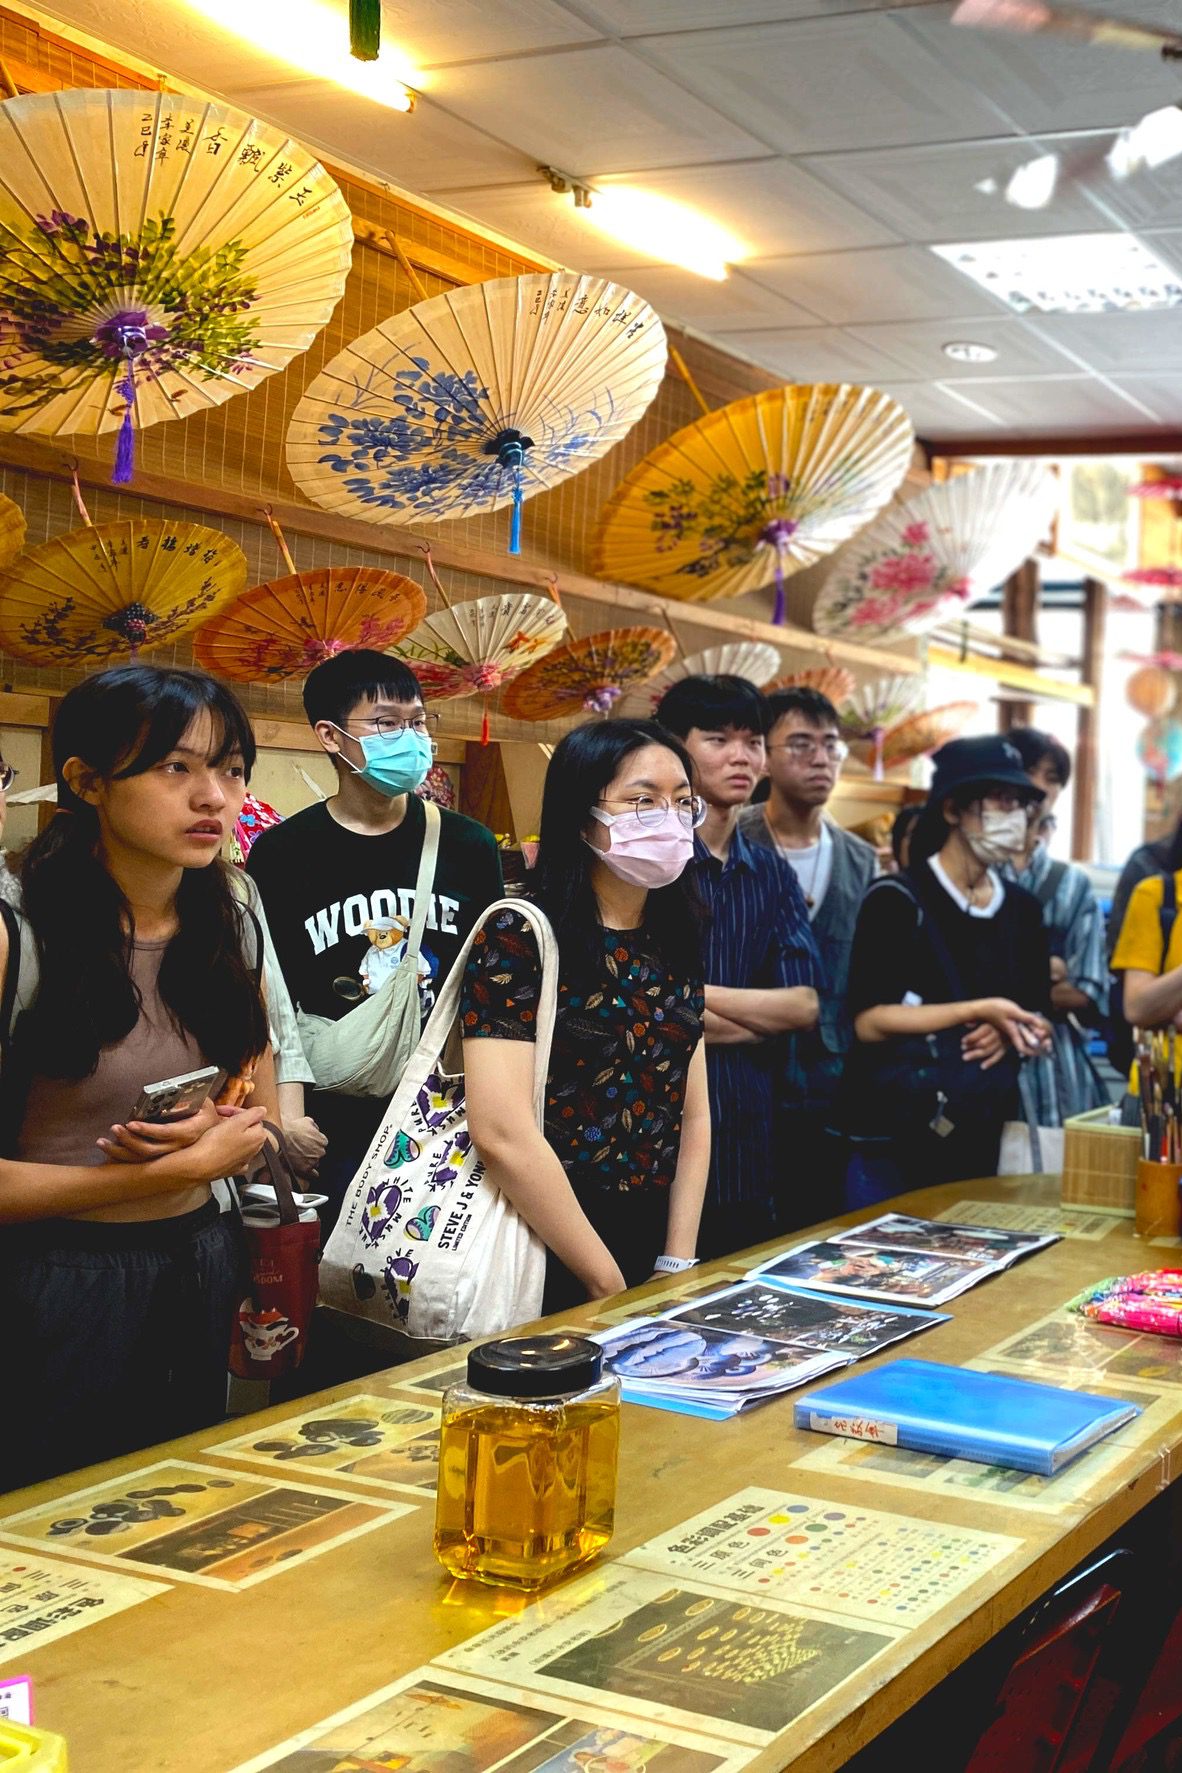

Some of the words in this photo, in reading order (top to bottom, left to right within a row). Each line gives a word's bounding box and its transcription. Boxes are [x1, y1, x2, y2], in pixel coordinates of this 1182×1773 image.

[346, 1203, 358, 1226] THE
[356, 1164, 372, 1199] BODY
[456, 1201, 468, 1211] J
[460, 1191, 475, 1200] &
[437, 1211, 464, 1250] STEVE
